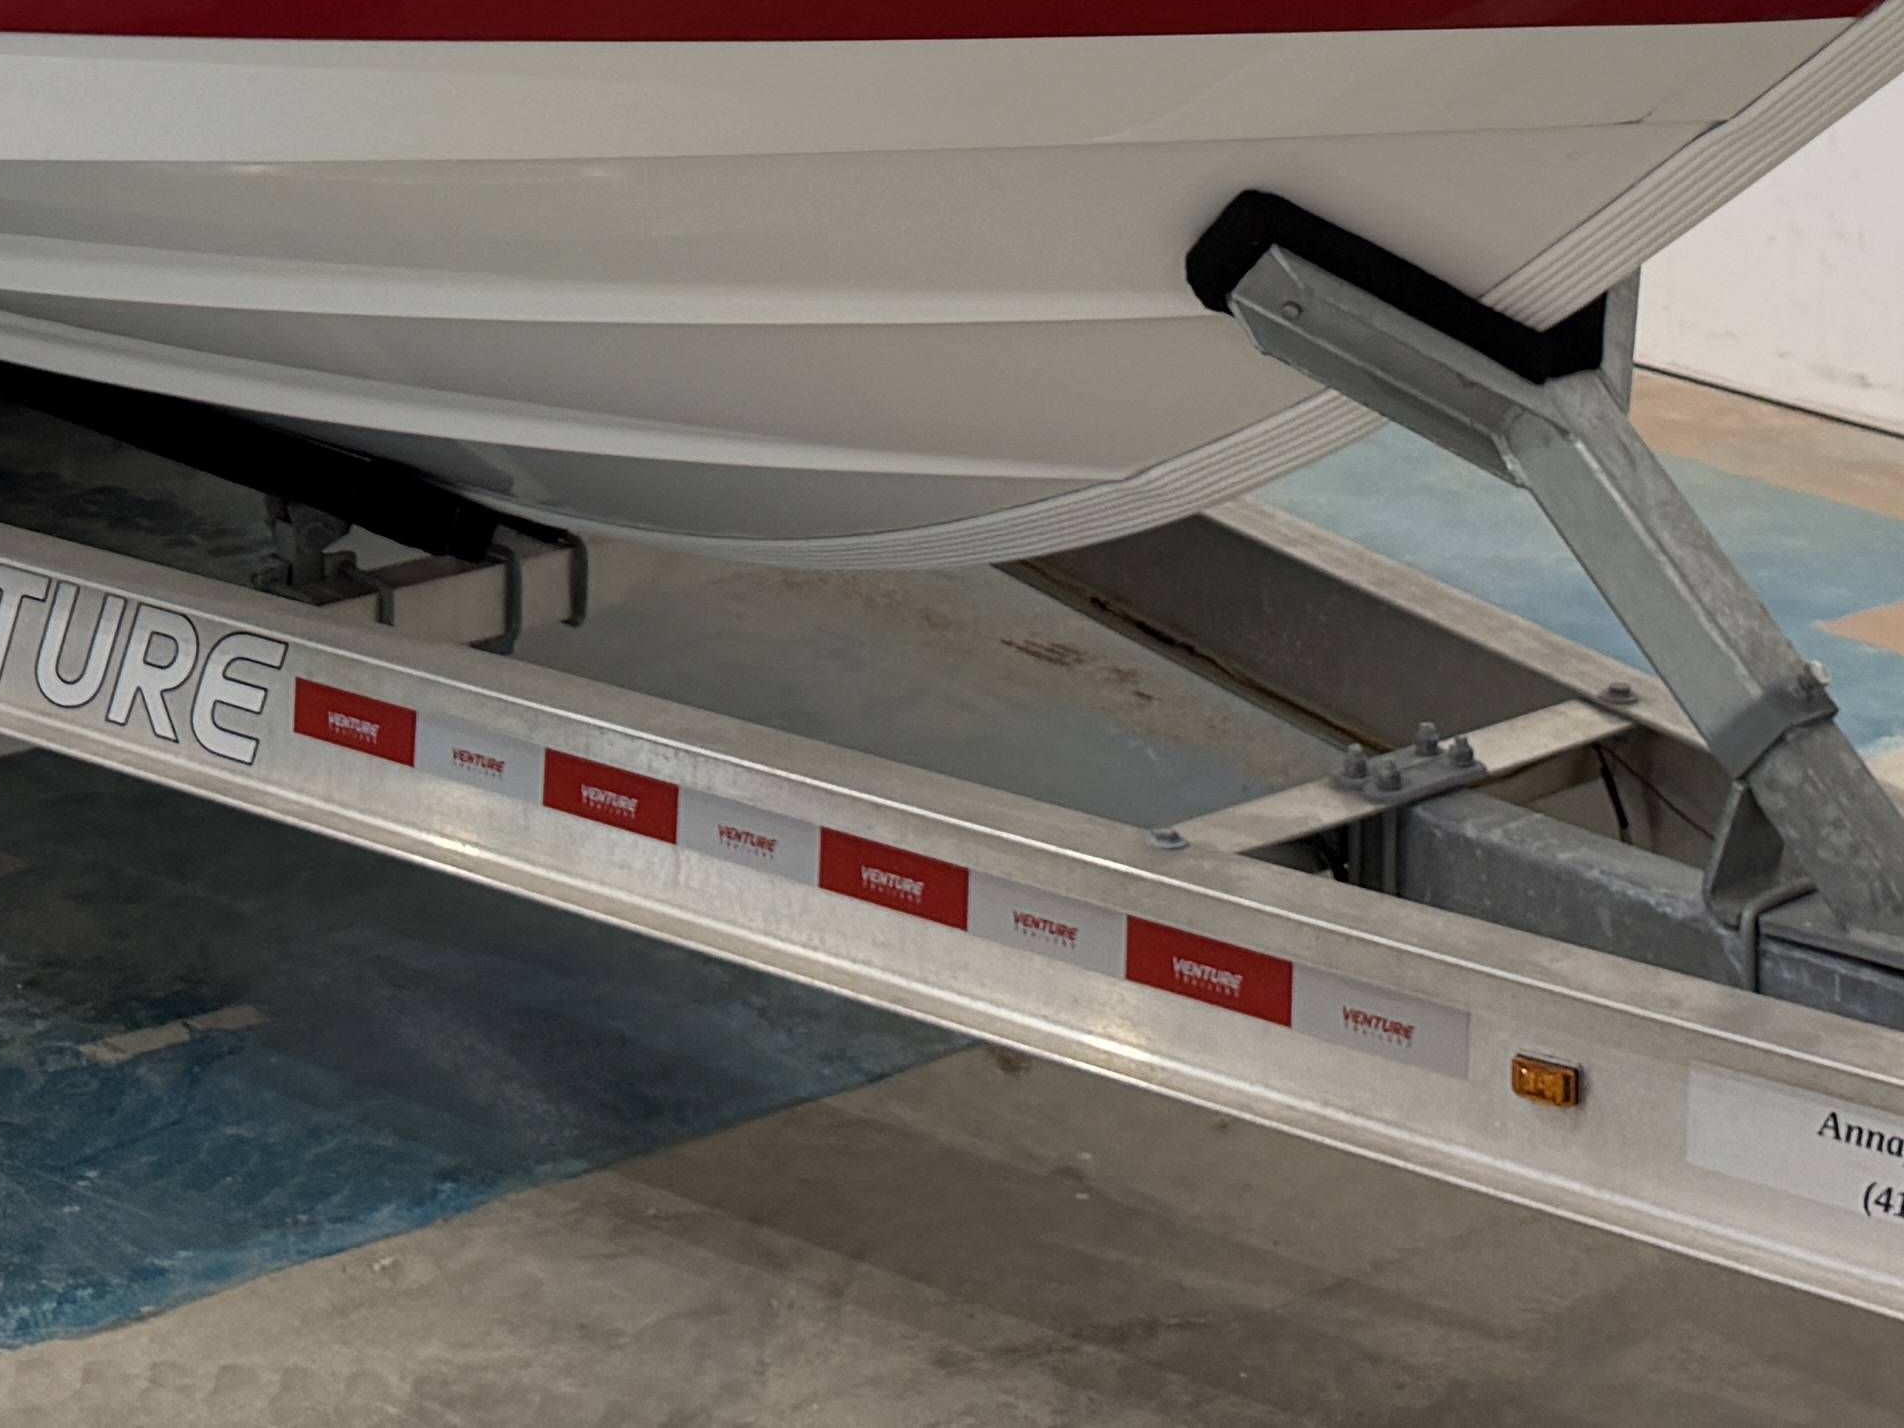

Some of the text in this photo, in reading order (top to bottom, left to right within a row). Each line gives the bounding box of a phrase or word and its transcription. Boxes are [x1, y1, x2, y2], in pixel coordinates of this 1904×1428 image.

[327, 710, 380, 737] VENTURE
[453, 746, 505, 773] VENTURE
[581, 783, 639, 813] VENTURE
[718, 823, 777, 852] VENTURE
[860, 864, 925, 895] VENTURE
[1013, 909, 1079, 941] VENTURE
[1172, 955, 1243, 988] VENTURE
[1343, 1005, 1416, 1040] VENTURE
